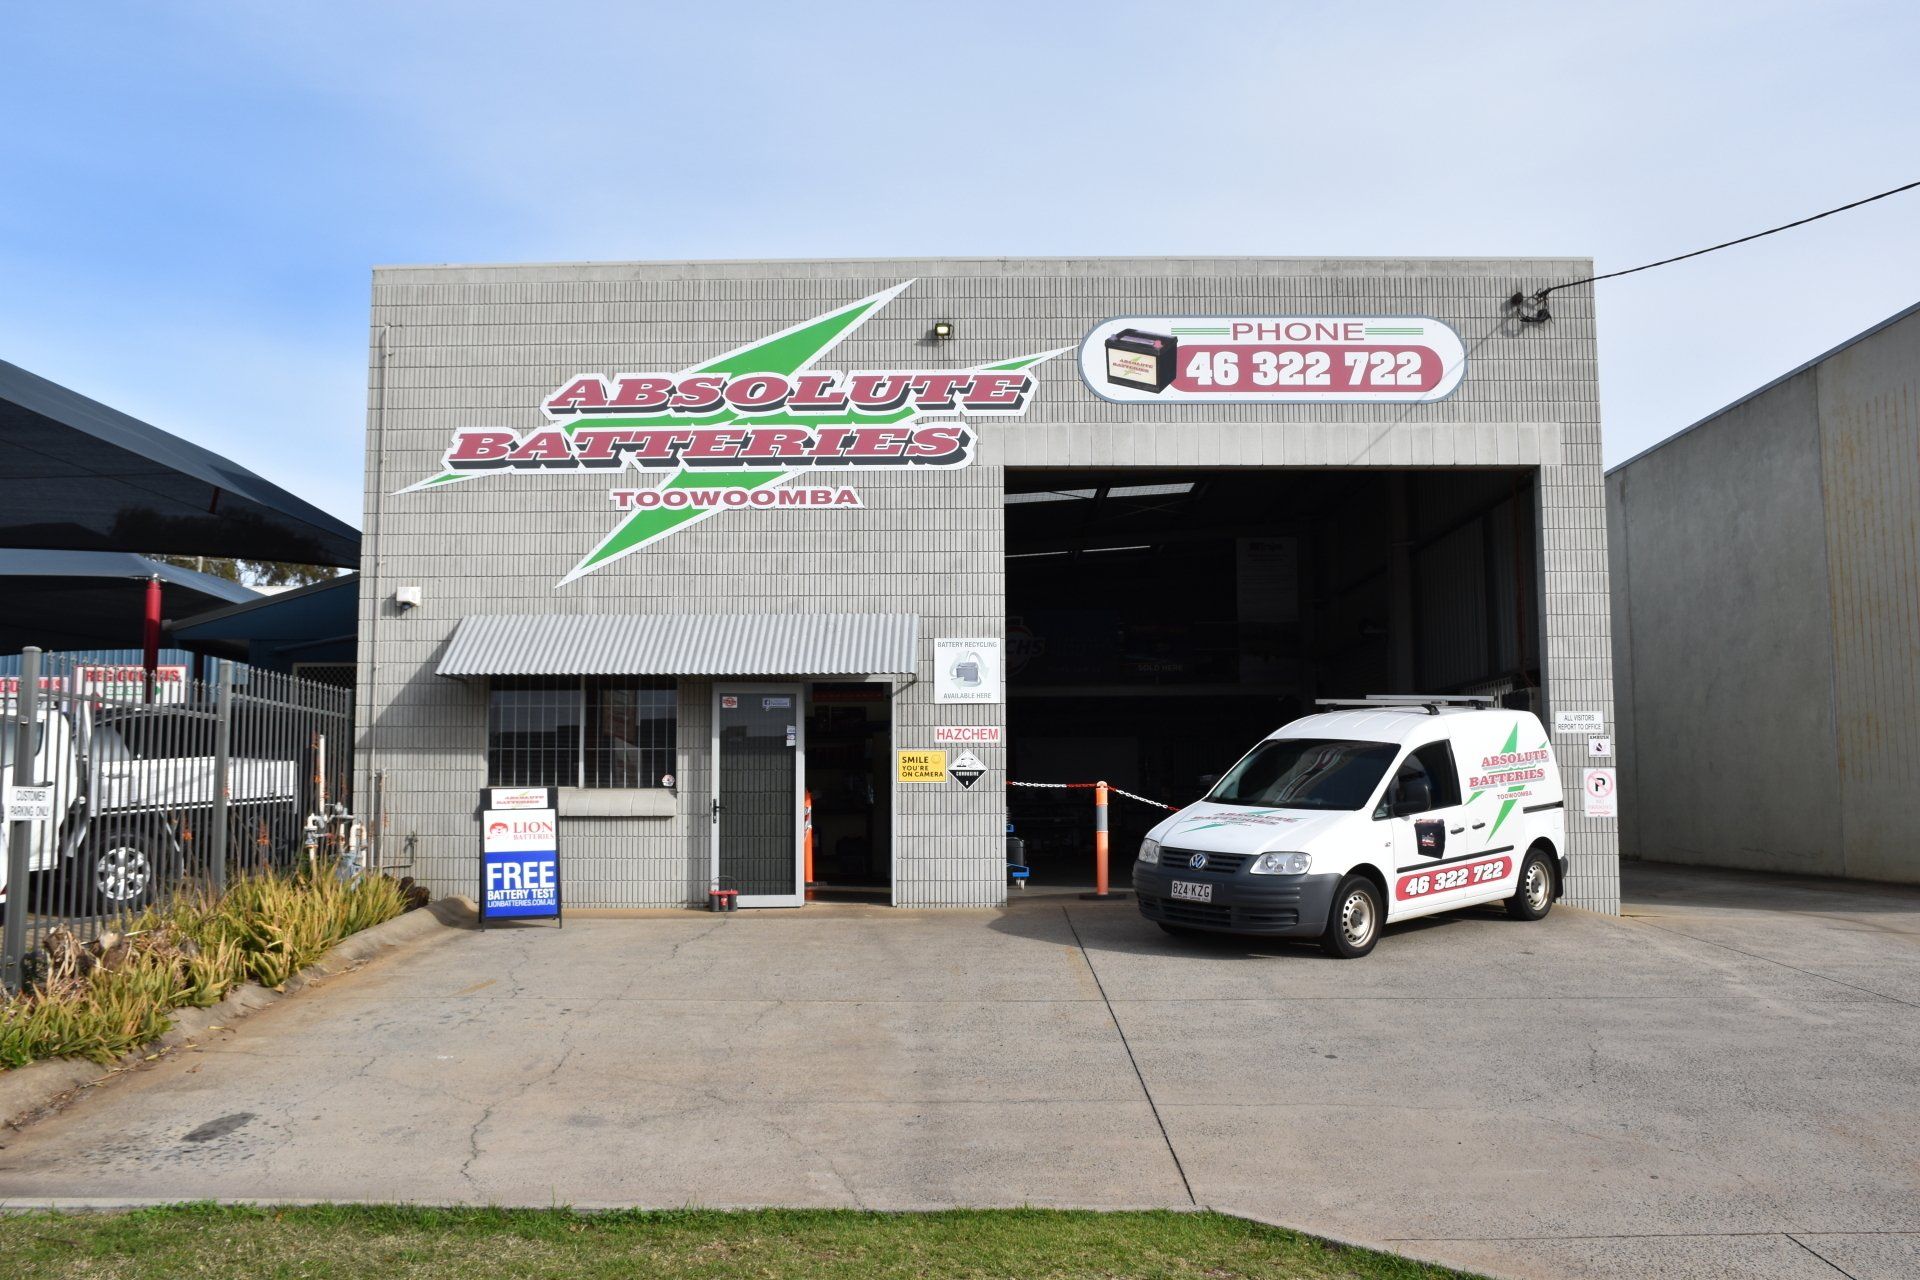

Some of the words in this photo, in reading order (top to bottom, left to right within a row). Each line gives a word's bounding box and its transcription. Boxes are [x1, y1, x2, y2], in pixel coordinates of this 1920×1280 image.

[1232, 322, 1364, 341] PHONE
[1185, 351, 1240, 386] 46
[1252, 351, 1331, 386] 322
[1344, 351, 1422, 386] 722
[547, 376, 1031, 415] ABSOLUTE
[448, 425, 974, 469] BATTERIES
[613, 488, 860, 509] TOOWOOMBA
[936, 728, 999, 740] HAZCHEM
[902, 756, 929, 764] SMILE
[1481, 749, 1549, 768] ABSOLUTE
[1469, 768, 1545, 788] BATTERIES
[16, 790, 47, 801] CUSTOMER
[1497, 790, 1532, 800] TOOWOOMBA
[10, 805, 34, 817] PARKING
[36, 805, 50, 817] ONLY
[513, 821, 553, 833] LION
[487, 862, 555, 889] FREE
[1405, 875, 1431, 896] 46
[1434, 868, 1469, 891] 322
[1473, 861, 1504, 883] 722
[487, 889, 530, 900] BATTERY
[531, 888, 555, 899] TEST
[487, 898, 556, 908] LIONBATTERIES.COM.AU
